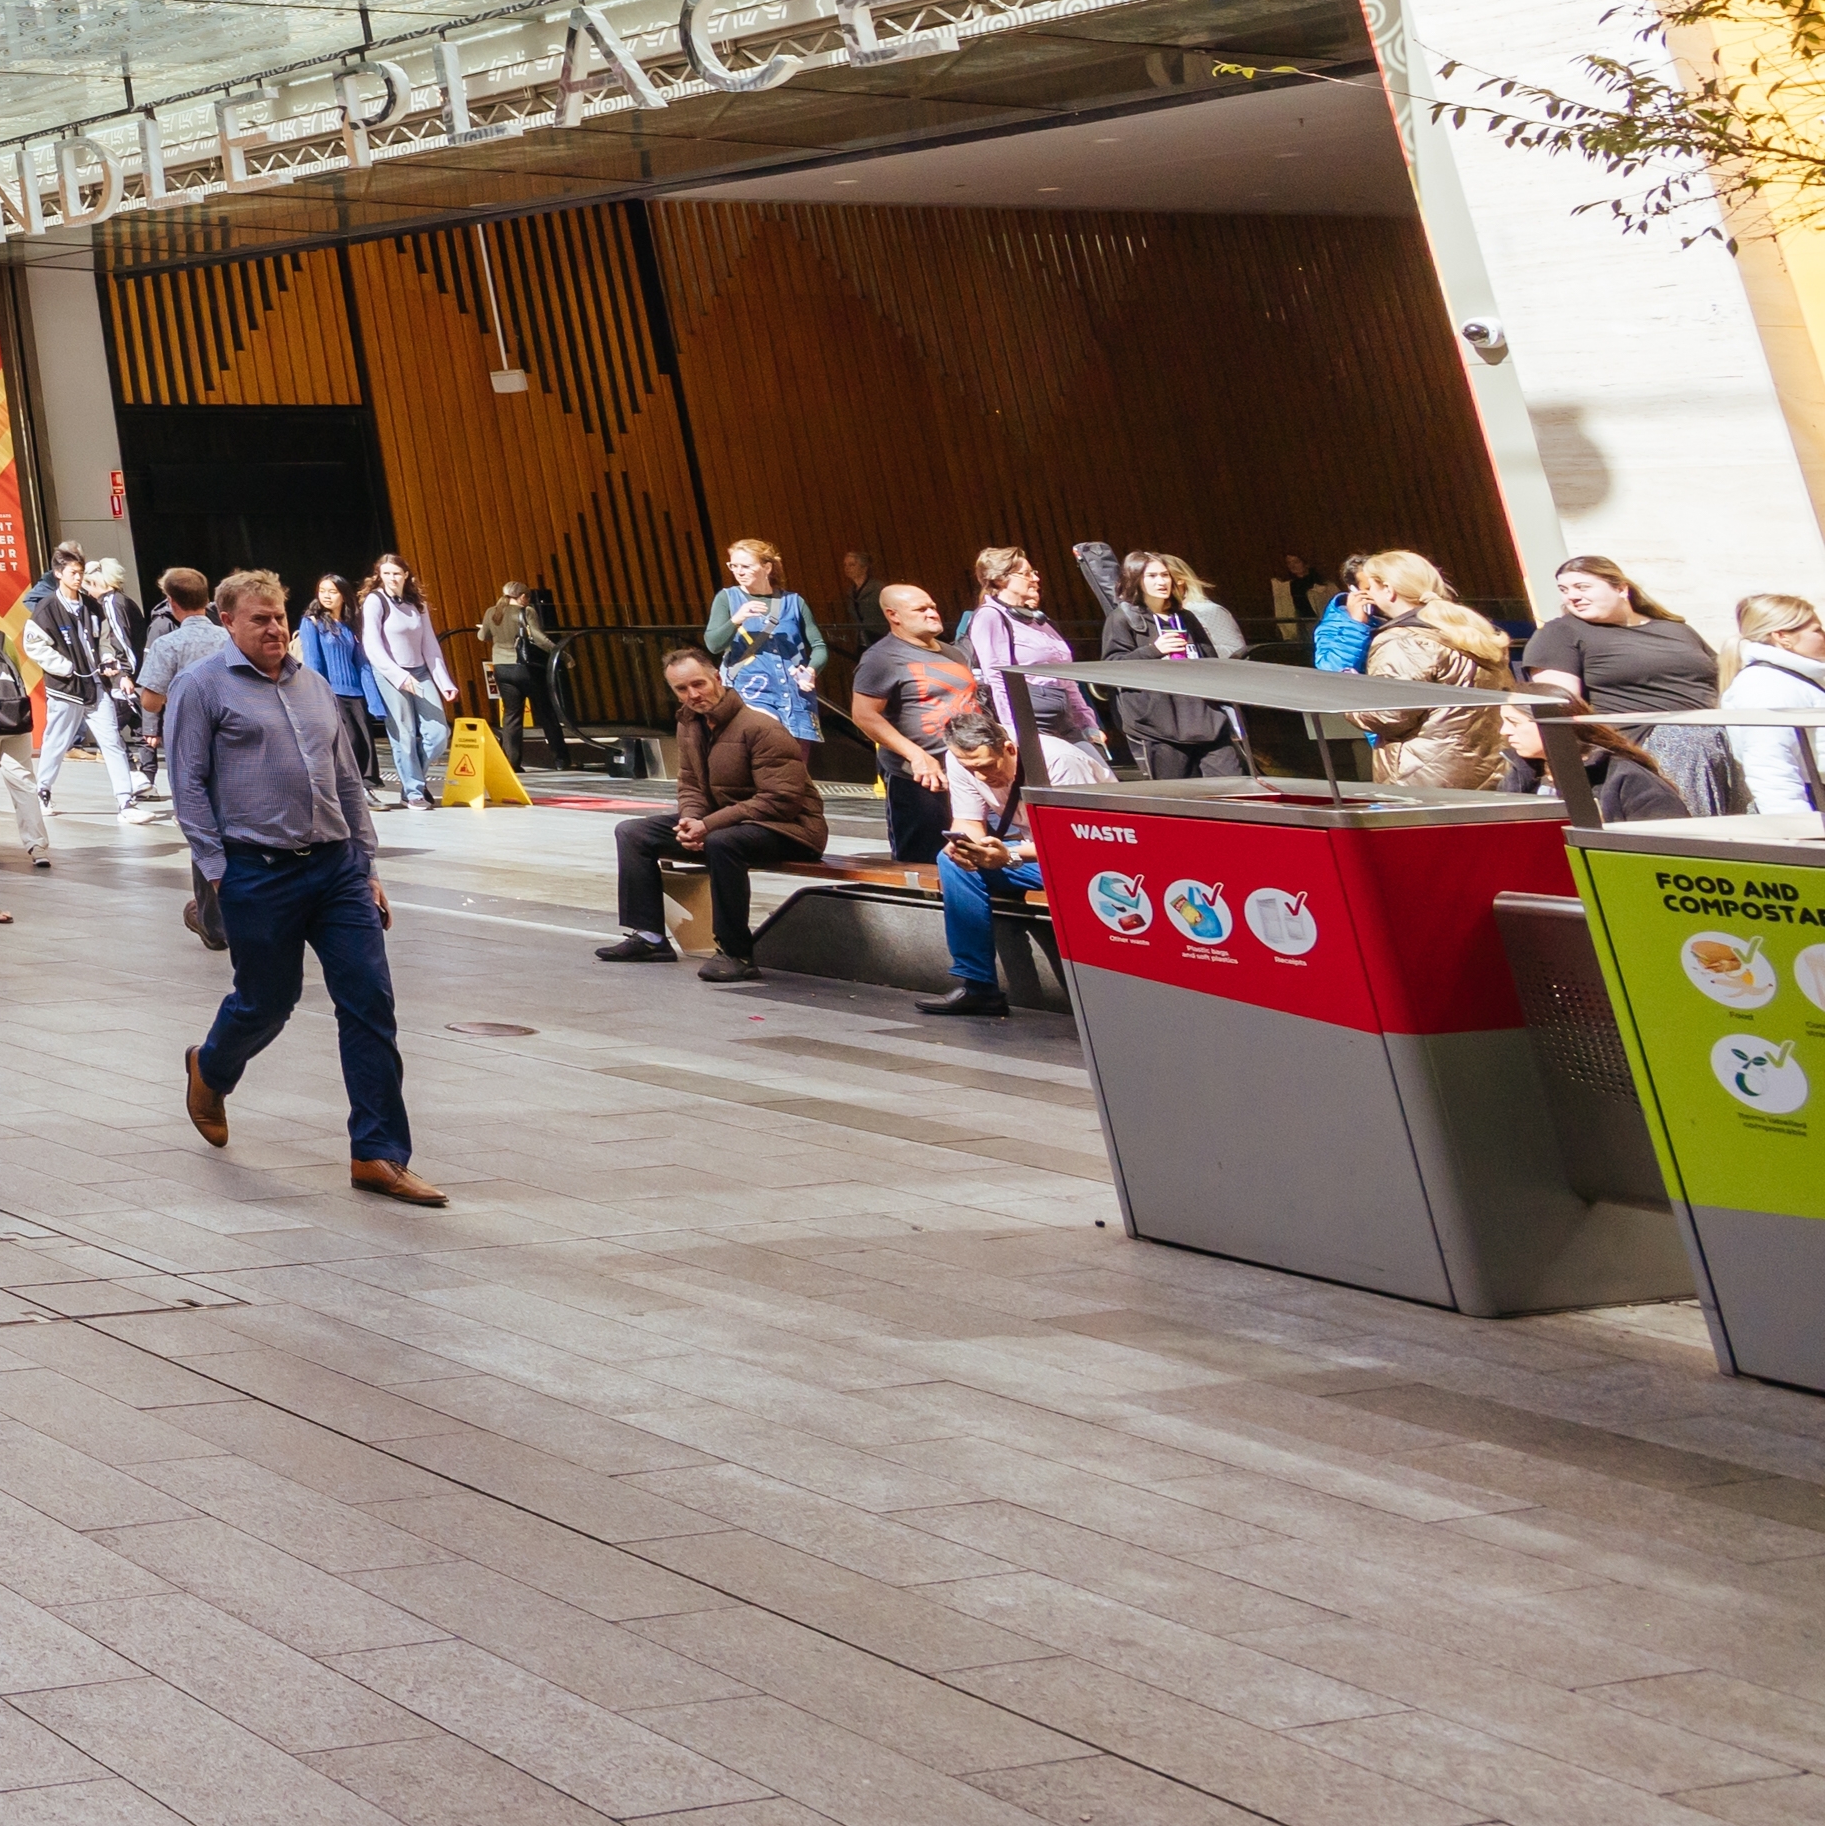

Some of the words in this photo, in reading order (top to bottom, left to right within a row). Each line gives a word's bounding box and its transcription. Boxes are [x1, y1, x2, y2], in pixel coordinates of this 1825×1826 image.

[1070, 823, 1138, 844] WASTE
[1655, 872, 1735, 896] FOOD
[1743, 880, 1799, 902] AND
[1109, 935, 1128, 945] Other
[1129, 937, 1150, 946] waste
[1186, 944, 1210, 955] Plastic
[1211, 947, 1229, 956] bags
[1182, 951, 1195, 959] and
[1196, 953, 1210, 962] soft
[1211, 954, 1238, 965] plastics
[1274, 956, 1307, 966] Receipts
[1729, 1010, 1754, 1021] Food
